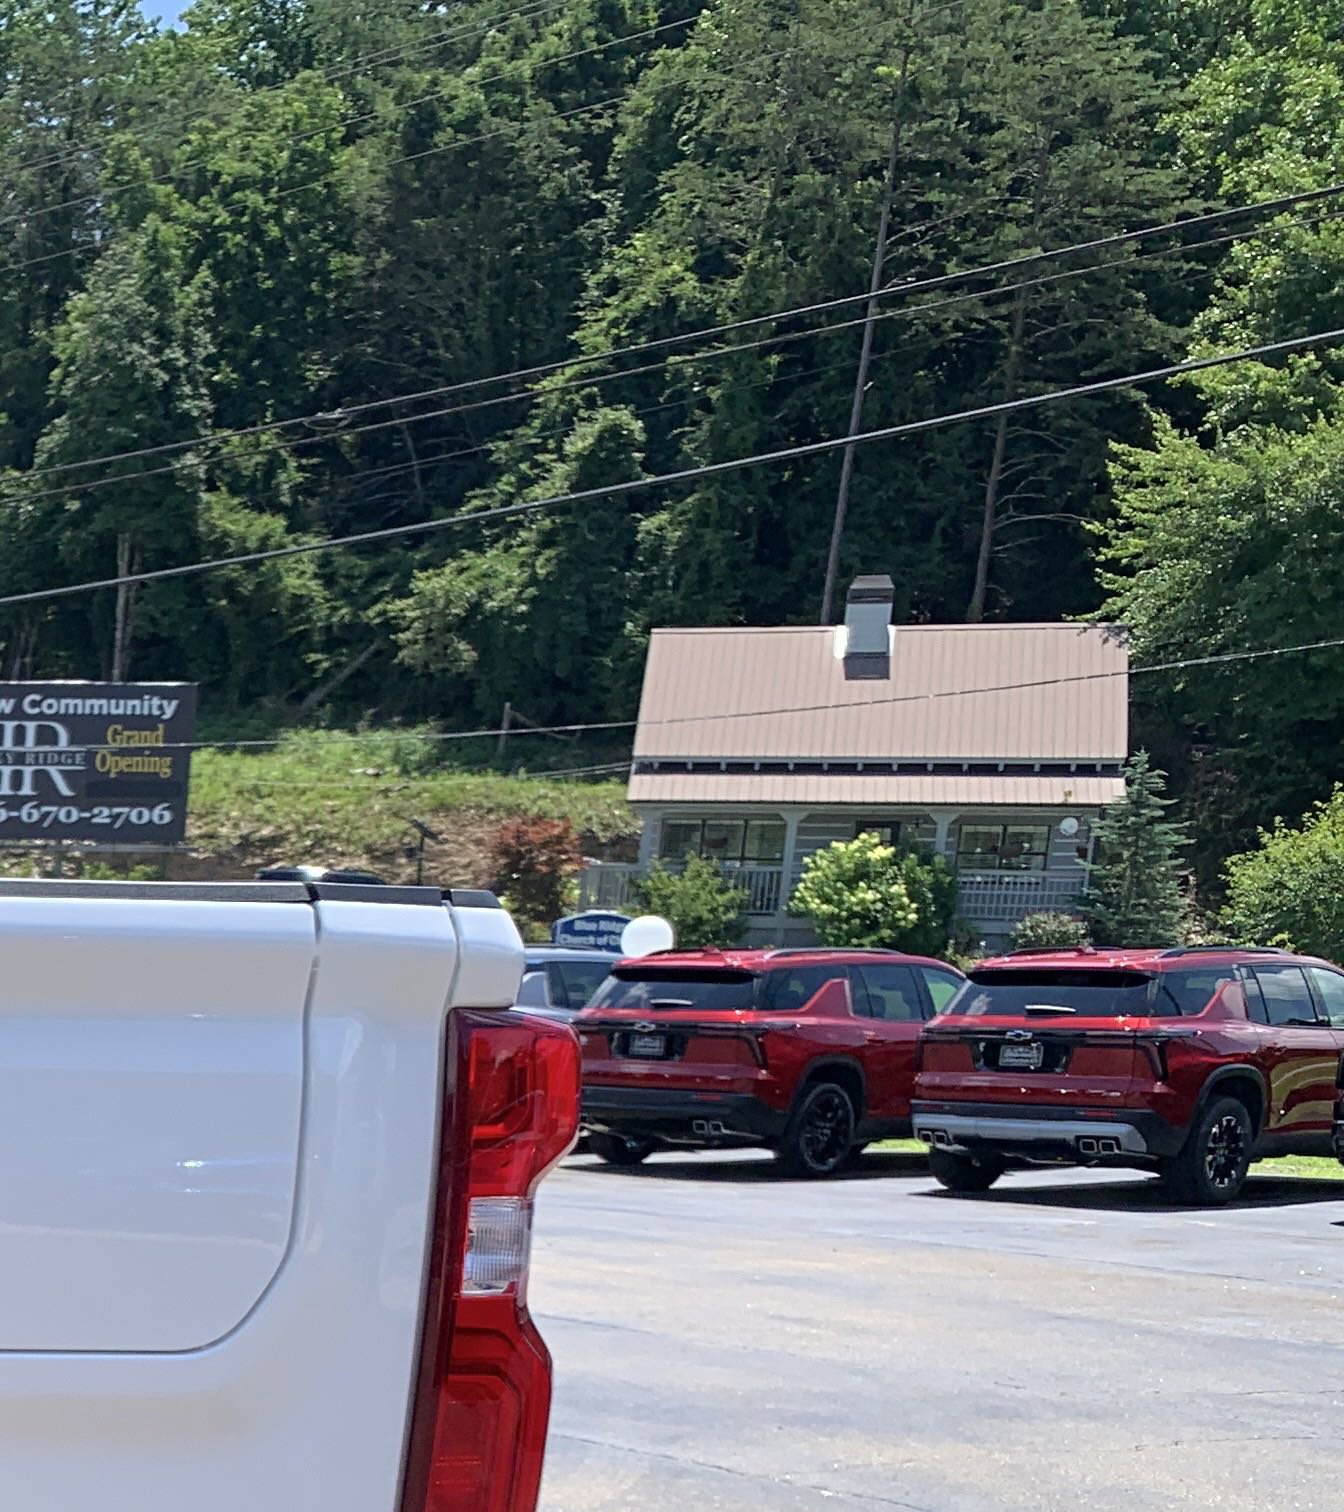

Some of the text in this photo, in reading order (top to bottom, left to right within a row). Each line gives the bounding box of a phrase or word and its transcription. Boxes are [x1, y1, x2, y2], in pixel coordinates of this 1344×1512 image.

[22, 694, 179, 719] Community
[107, 724, 165, 746] Grand
[25, 752, 86, 765] RIDGE
[95, 751, 172, 778] Opening
